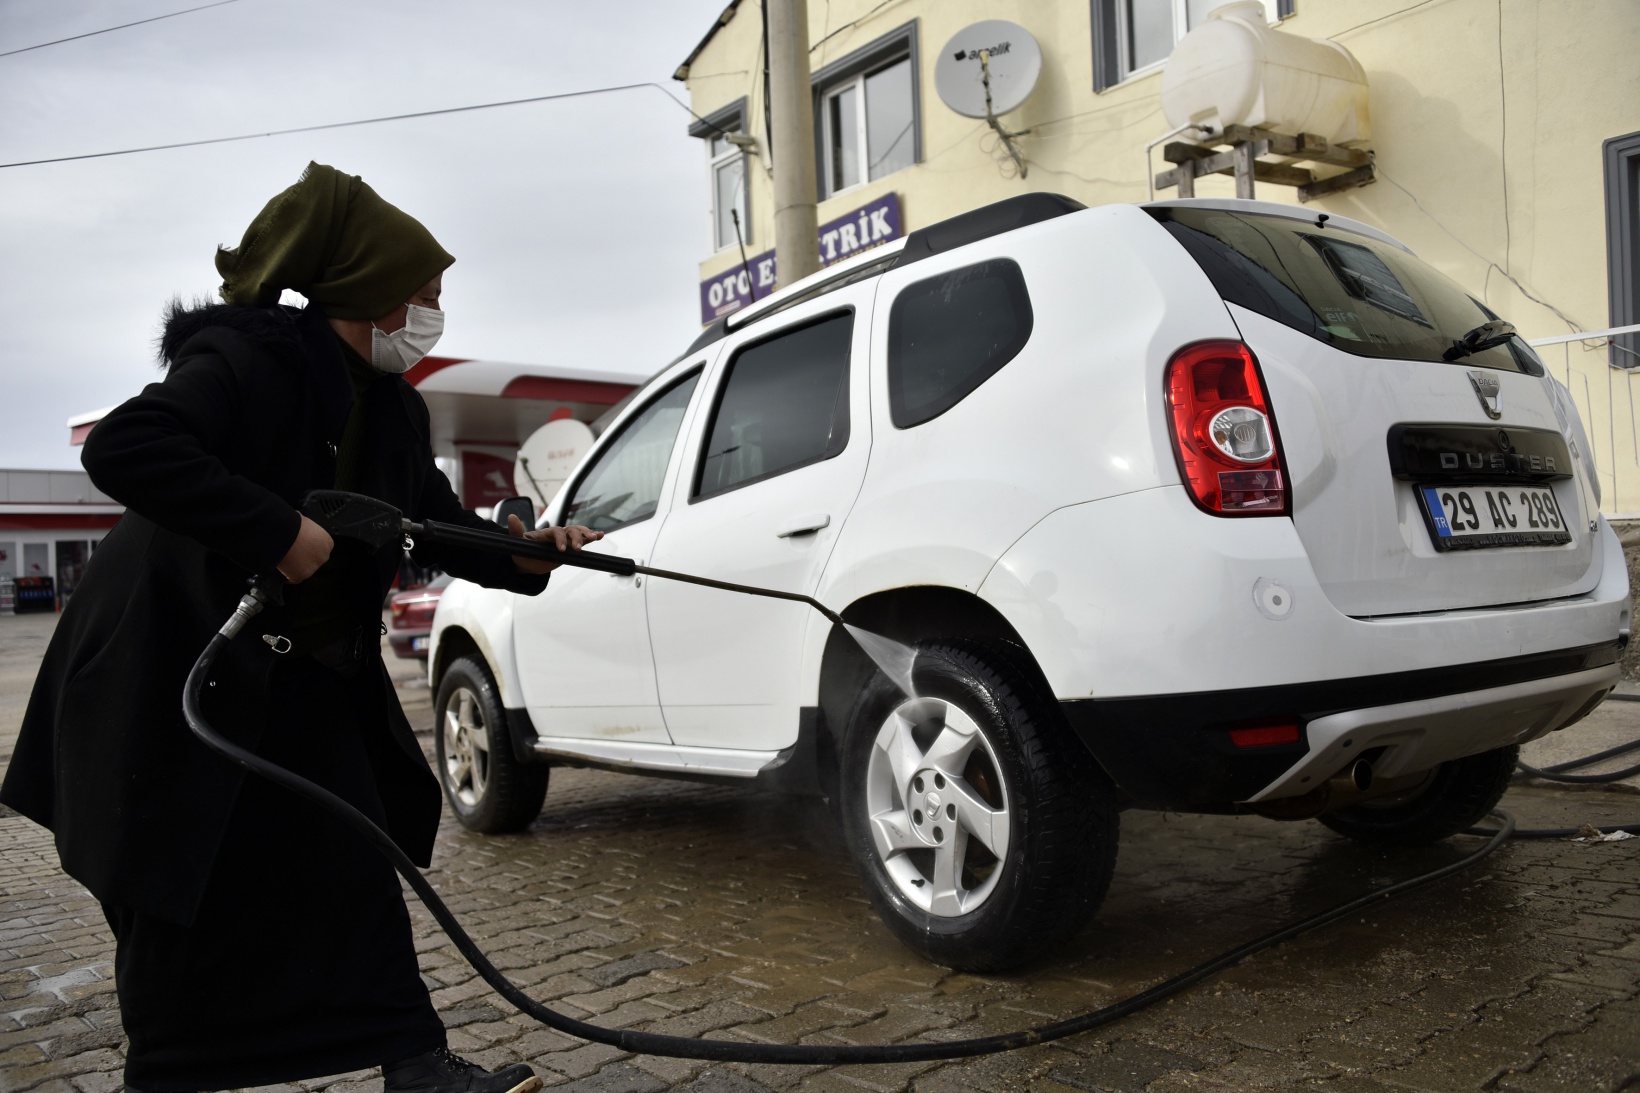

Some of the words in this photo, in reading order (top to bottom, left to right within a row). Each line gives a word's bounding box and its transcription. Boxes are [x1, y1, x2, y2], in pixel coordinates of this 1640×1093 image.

[708, 269, 753, 308] OTO
[1478, 378, 1499, 387] DACIA
[1440, 452, 1556, 472] DUSTER
[1443, 491, 1480, 530] 29
[1485, 491, 1518, 529] AC
[1521, 492, 1561, 529] 289
[1434, 516, 1449, 529] TR
